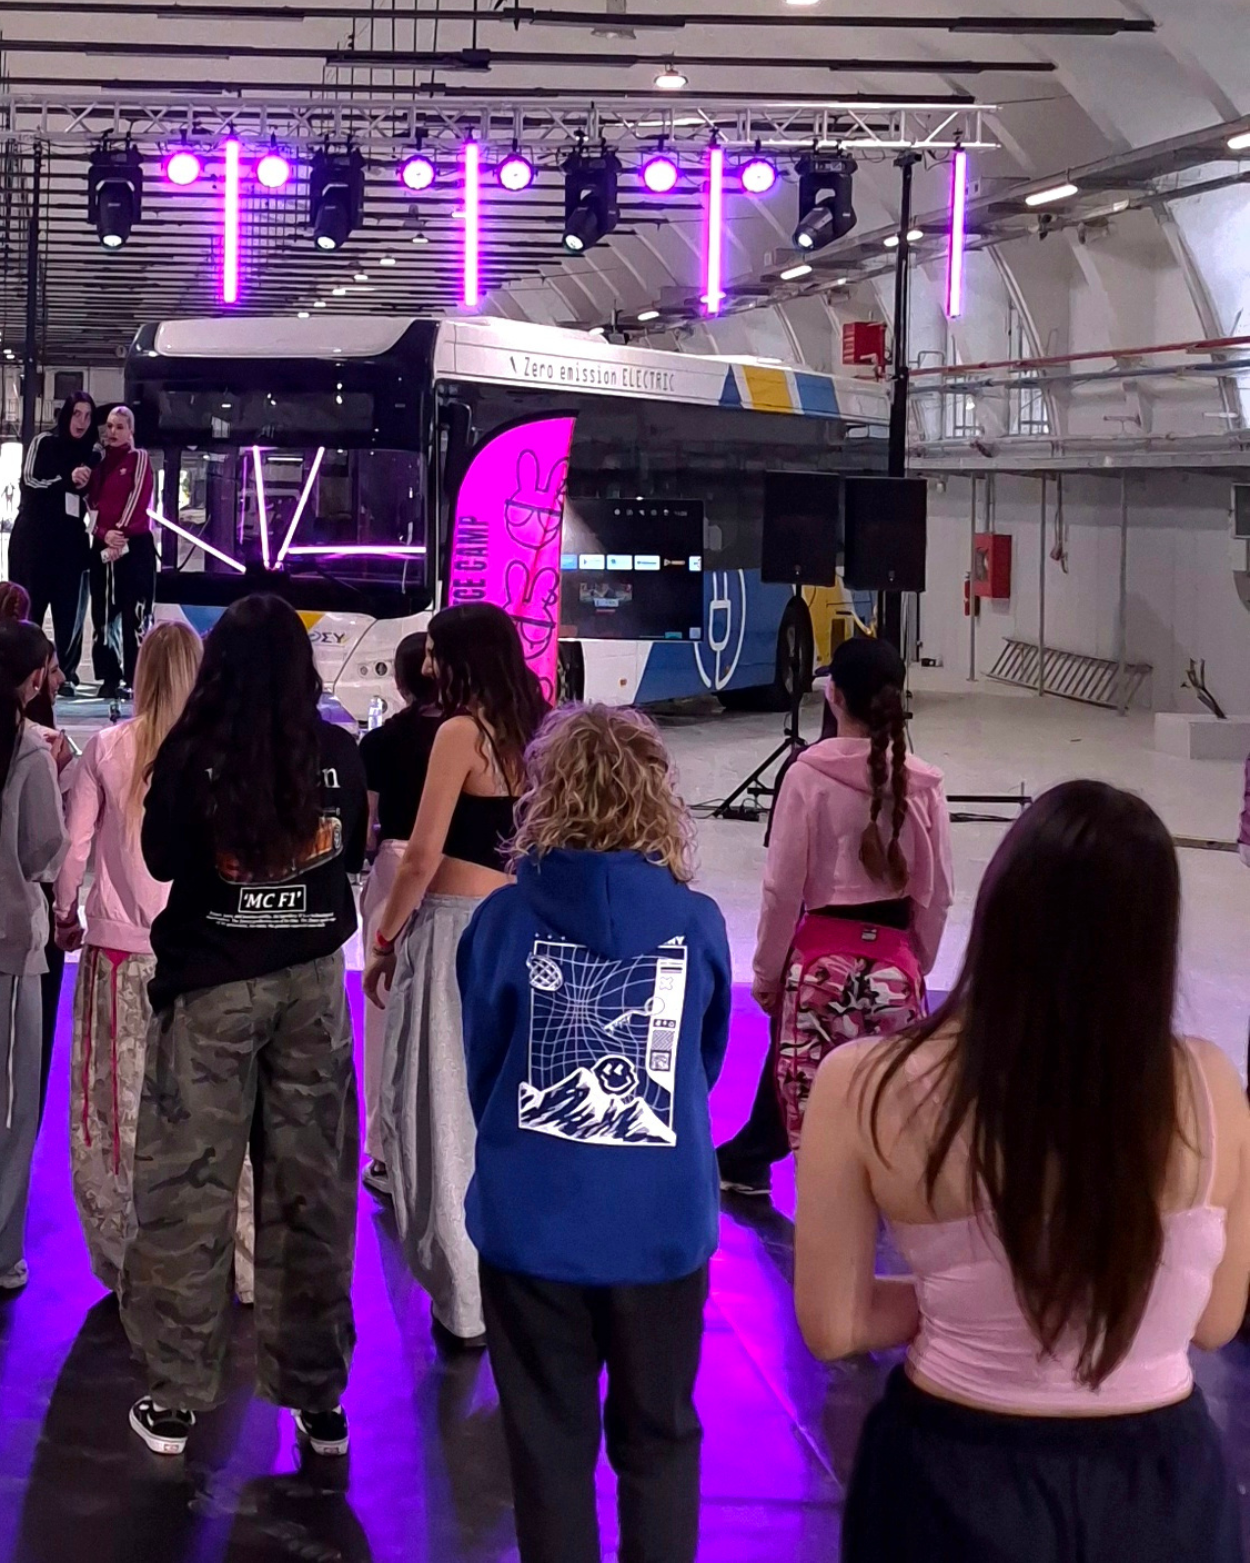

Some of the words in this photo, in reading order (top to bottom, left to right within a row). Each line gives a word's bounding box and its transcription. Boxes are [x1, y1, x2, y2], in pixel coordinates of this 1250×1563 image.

[524, 356, 554, 379] Zero
[560, 362, 617, 386] emission
[622, 367, 675, 392] ELECTRIC
[454, 516, 490, 571] CAMP
